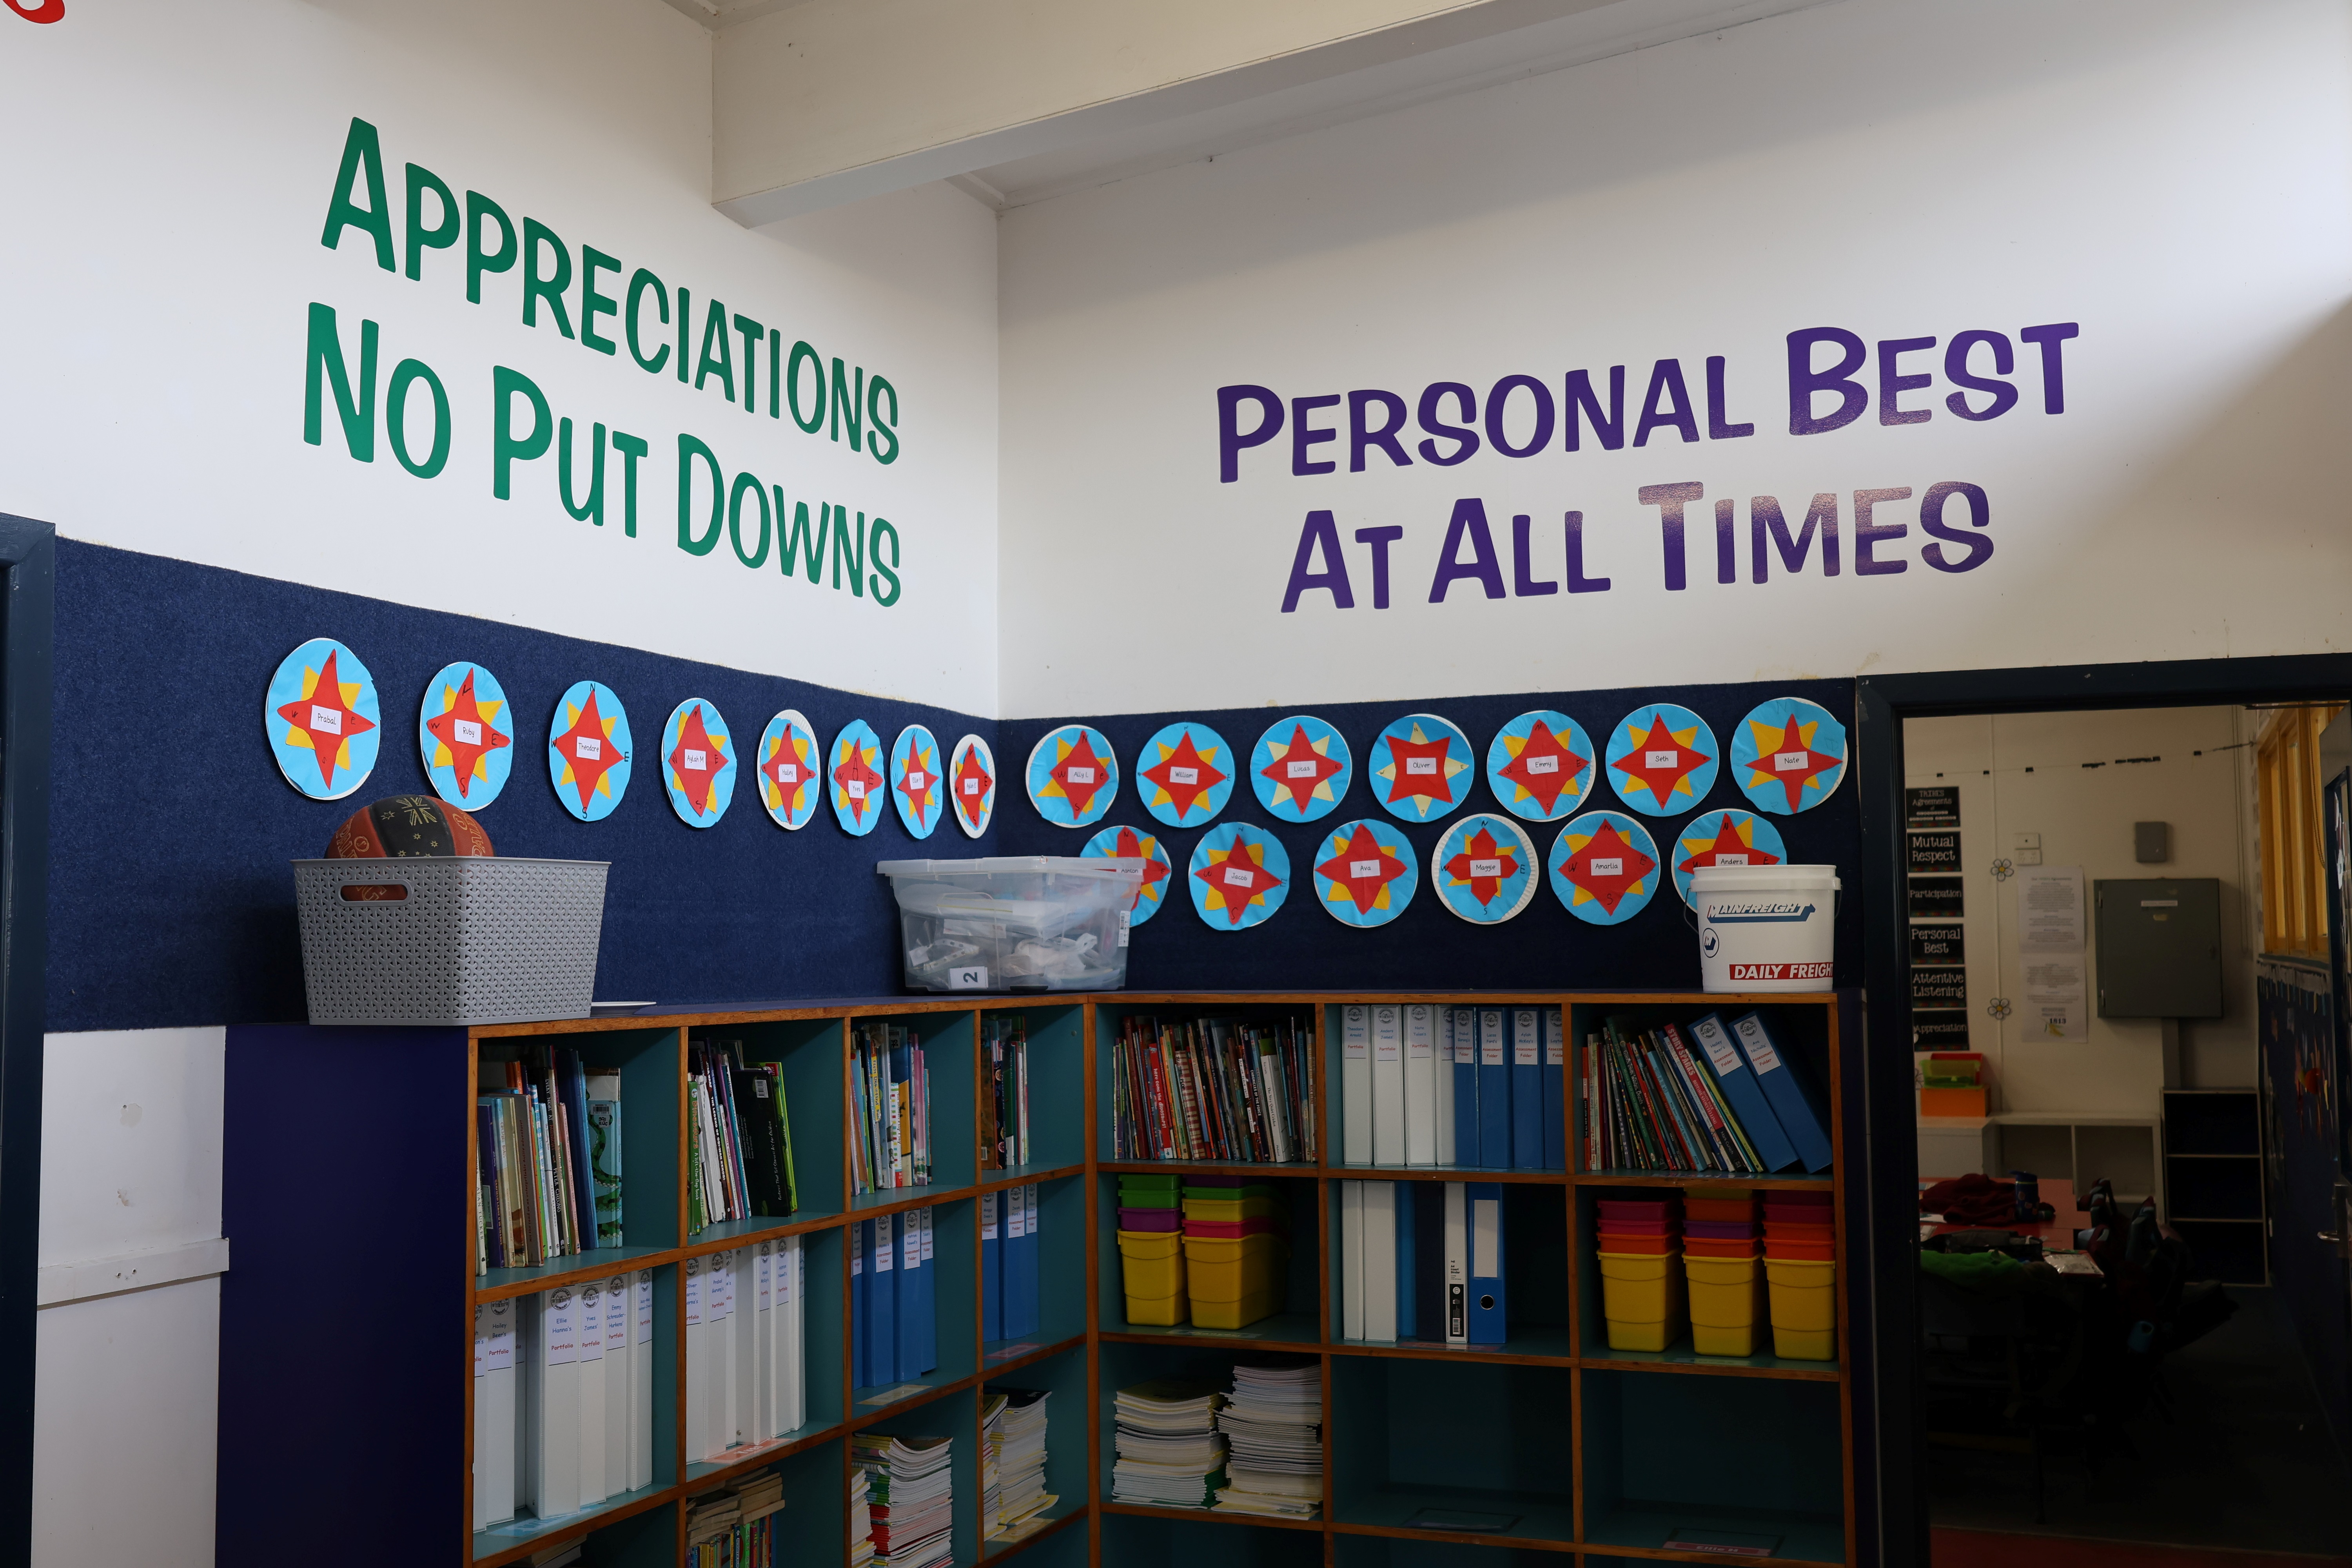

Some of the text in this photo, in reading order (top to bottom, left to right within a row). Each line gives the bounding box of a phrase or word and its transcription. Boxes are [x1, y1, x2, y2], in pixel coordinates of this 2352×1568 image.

[322, 118, 900, 464] APPRECIATIONS
[1218, 323, 2078, 483] PERSONAL BEST
[305, 303, 900, 607] NO PUT DOWNS
[1282, 483, 1993, 612] AT ALL TIMES
[590, 683, 595, 692] N
[318, 713, 336, 725] Prabal
[463, 727, 475, 737] Ruby
[491, 733, 499, 746] E
[1082, 734, 1088, 743] N
[578, 742, 599, 753] Theodore
[624, 752, 629, 762] E
[687, 755, 699, 764] Aylah
[1535, 761, 1552, 769] Emmy
[1912, 798, 1953, 807] Agreements
[582, 807, 588, 818] S
[1912, 835, 1954, 848] Mutual
[1640, 855, 1648, 866] E
[1912, 850, 1956, 864] Respect
[1520, 864, 1525, 874] E
[1568, 862, 1577, 873] W
[1231, 873, 1247, 881] Jacob
[1607, 893, 1613, 905] S
[1909, 889, 1962, 900] Participation
[1707, 903, 1808, 918] MAINFREIGHT
[1911, 928, 1961, 941] Personal
[1924, 942, 1949, 954] Best
[963, 971, 978, 983] 2
[1734, 965, 1784, 979] DAILY
[1913, 973, 1964, 984] Attentive
[1913, 985, 1965, 999] Listening
[1913, 1023, 1967, 1035] Appreciation
[1668, 1028, 1695, 1076] STORY SPARKS
[1714, 1051, 1734, 1064] Assessment
[1752, 1050, 1774, 1063] Assessment
[1721, 1059, 1733, 1067] Folder
[1692, 1080, 1717, 1125] BEDTIME STORYTELLING
[1158, 1103, 1167, 1128] dinosaurs!
[1724, 1140, 1734, 1155] Cunich
